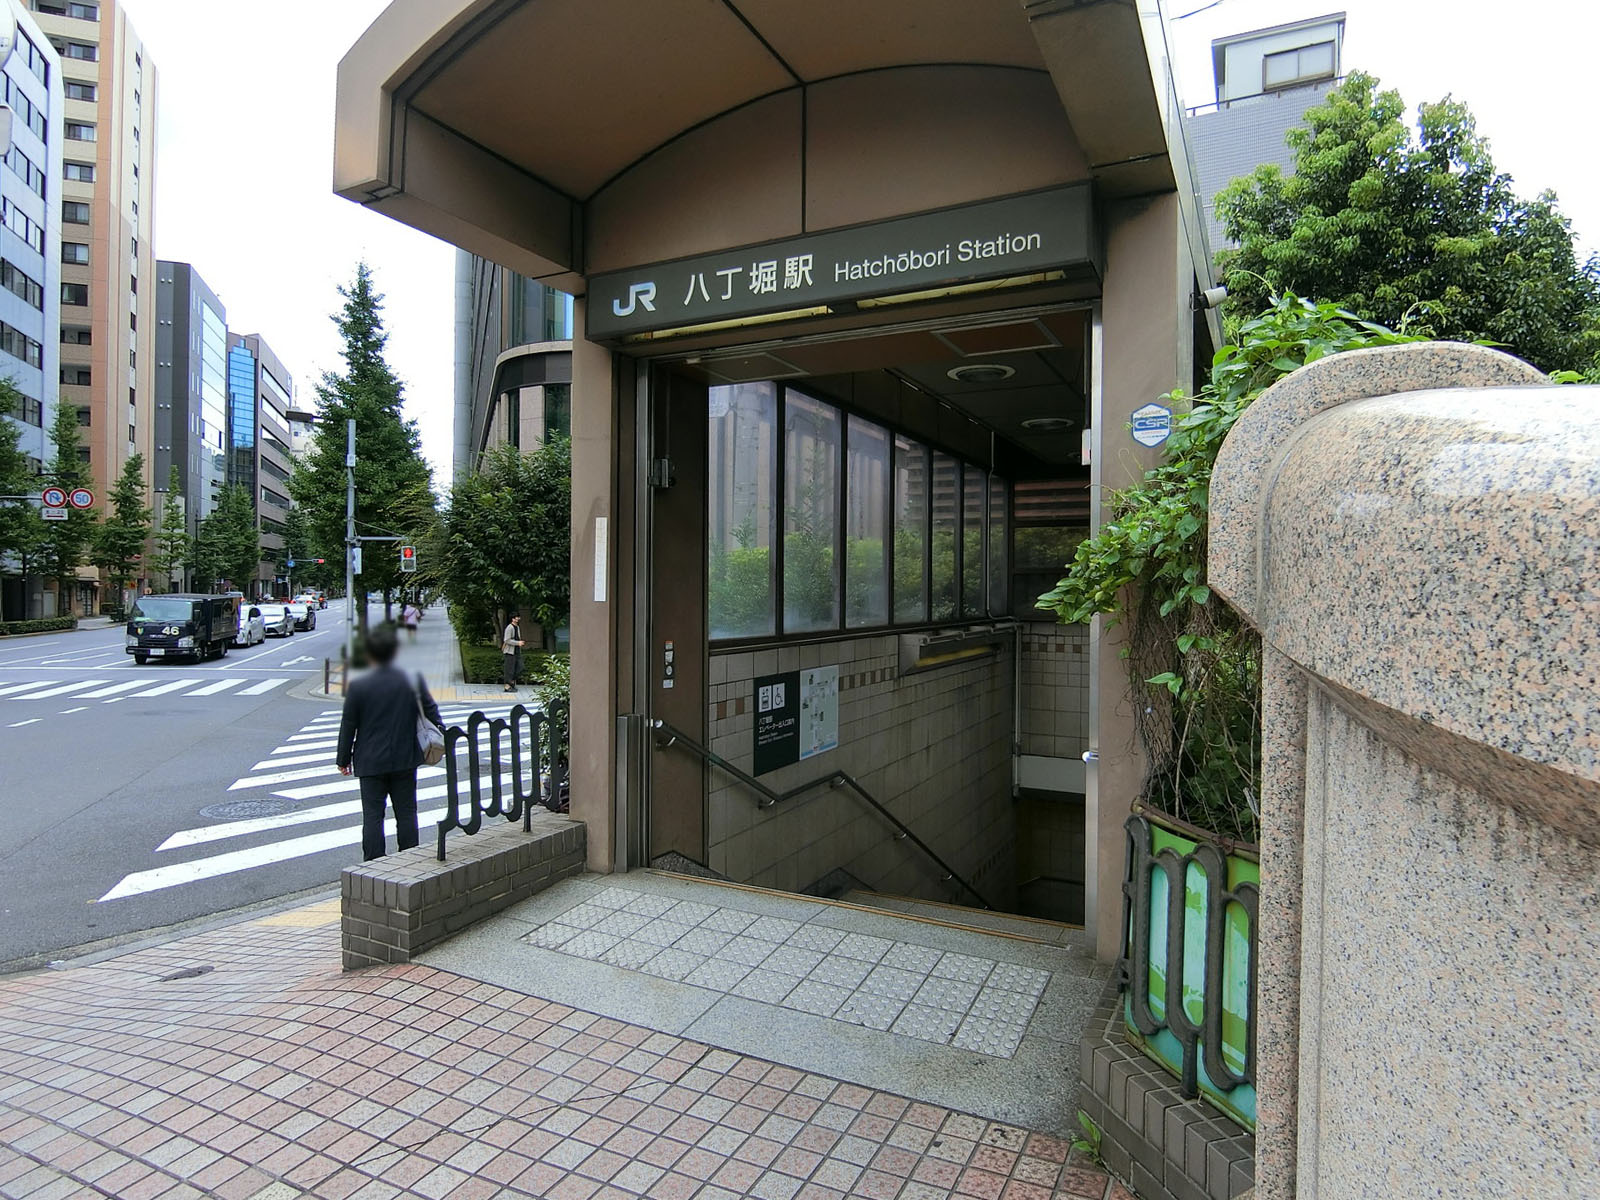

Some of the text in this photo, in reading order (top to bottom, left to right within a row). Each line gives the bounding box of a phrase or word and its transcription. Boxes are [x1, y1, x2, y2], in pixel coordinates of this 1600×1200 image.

[613, 232, 1041, 316] JR 八丁堀駅 Hatchōbori Station
[75, 493, 89, 504] 50
[161, 626, 180, 636] 46
